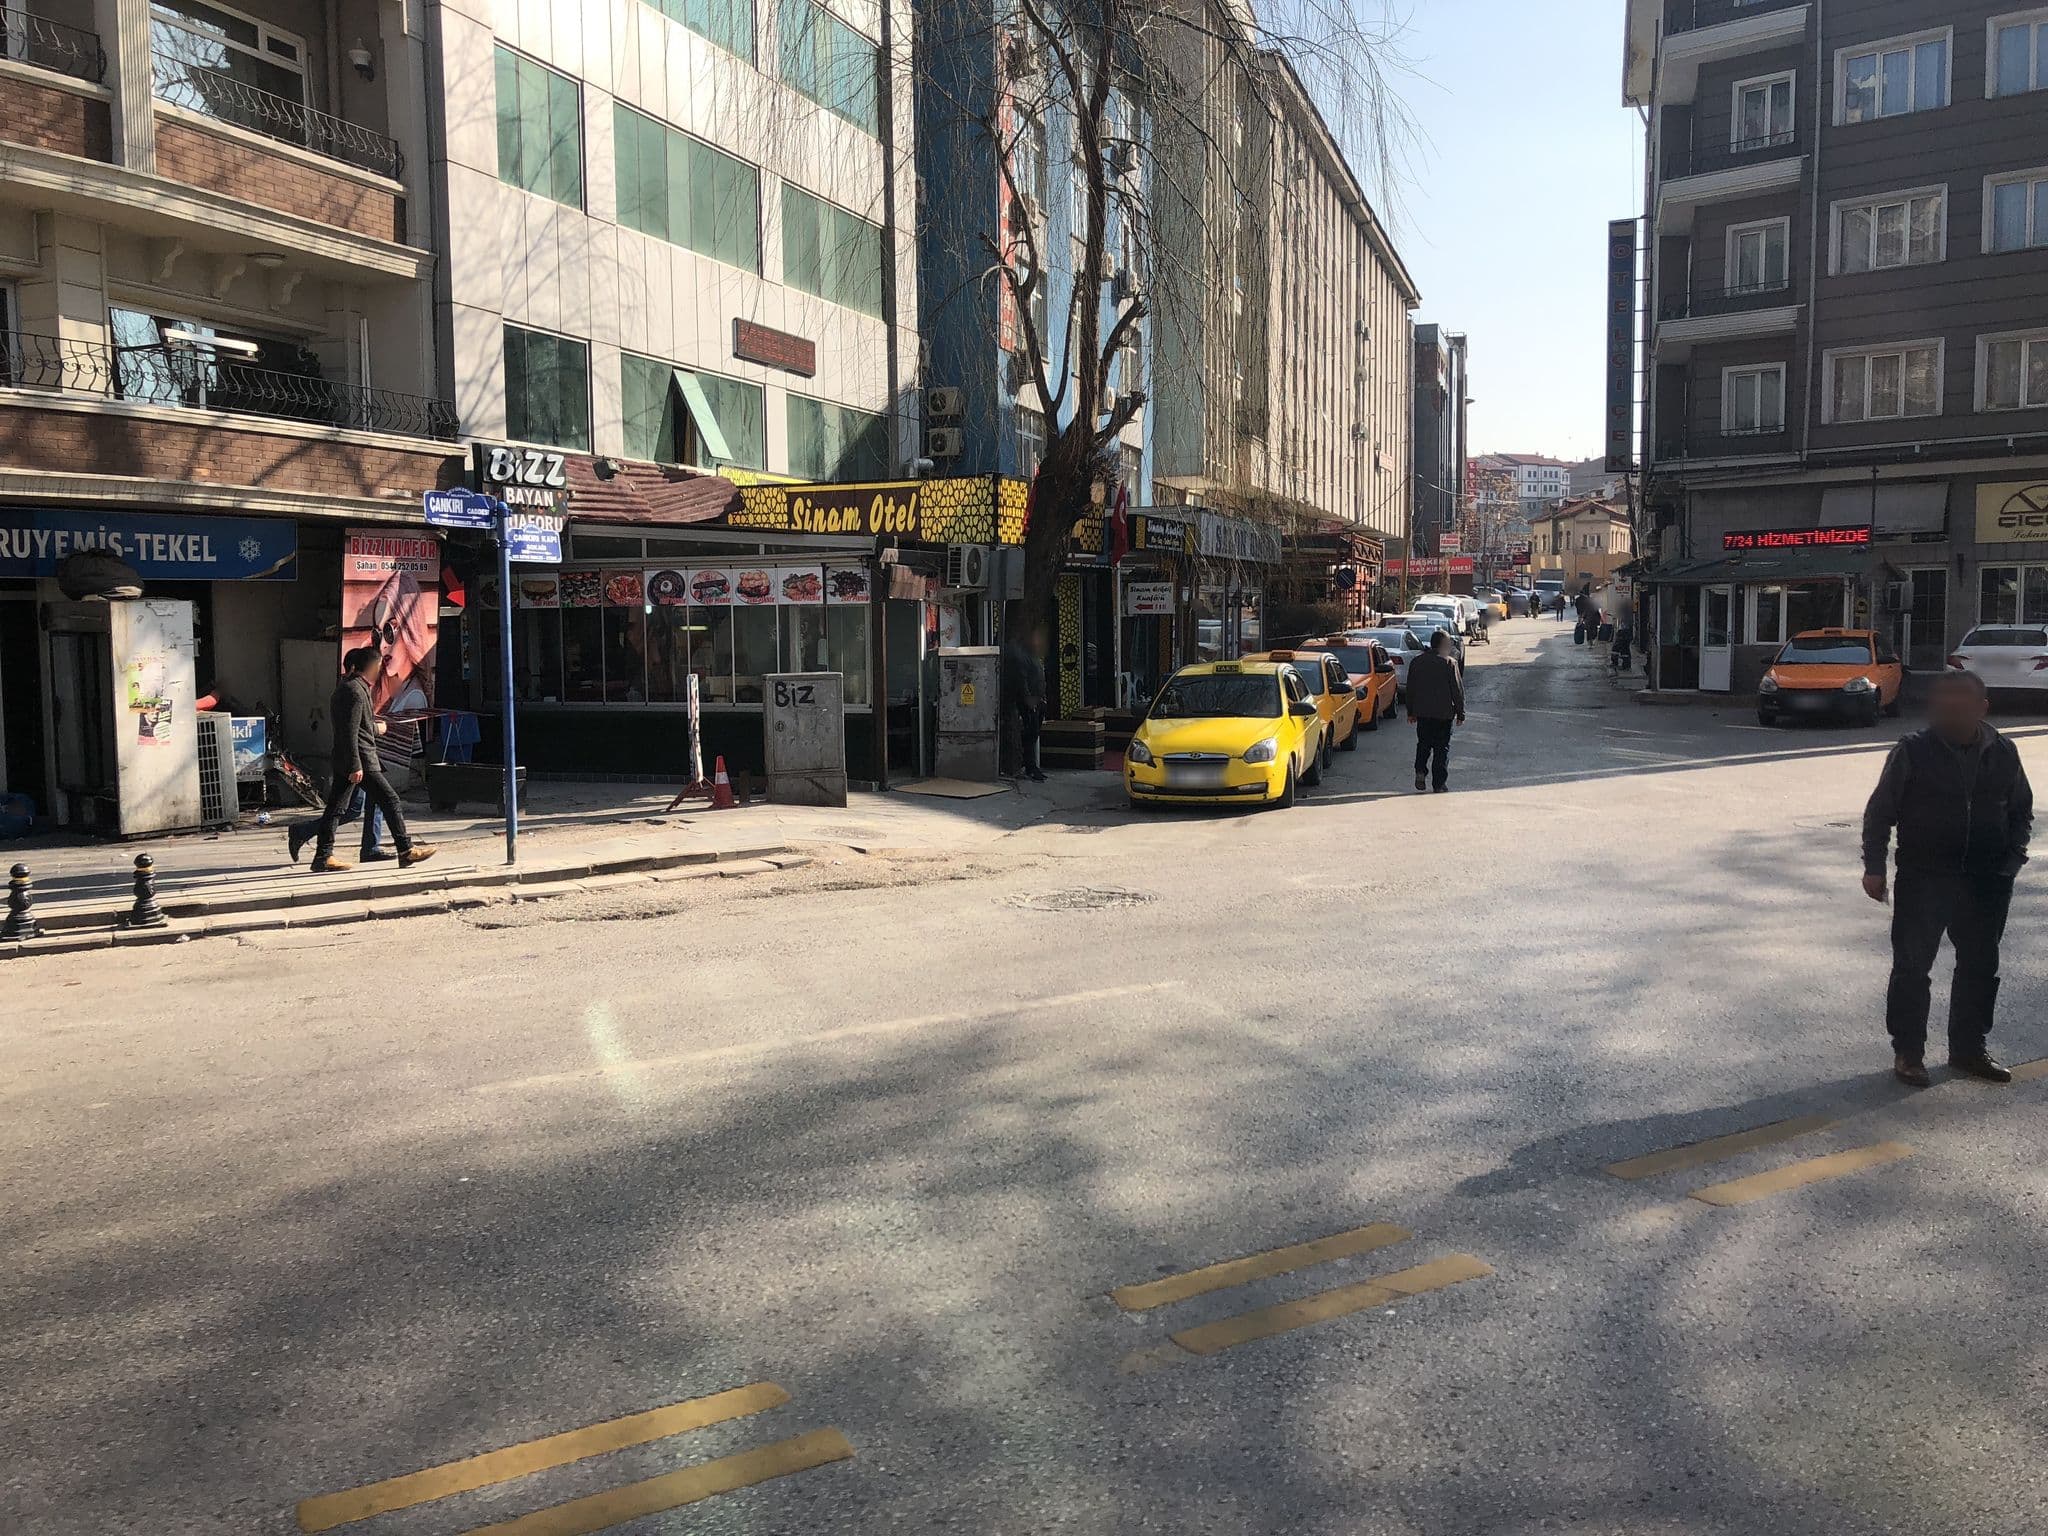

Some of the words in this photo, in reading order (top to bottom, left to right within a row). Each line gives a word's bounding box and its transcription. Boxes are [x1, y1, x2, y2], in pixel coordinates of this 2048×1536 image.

[429, 496, 464, 515] ÇANKIRI
[505, 487, 555, 507] BAYAN
[869, 491, 918, 534] Otel
[1724, 535, 1753, 548] 7/24
[1757, 529, 1869, 546] HİZMETİNİZDE
[232, 723, 252, 740] ikli
